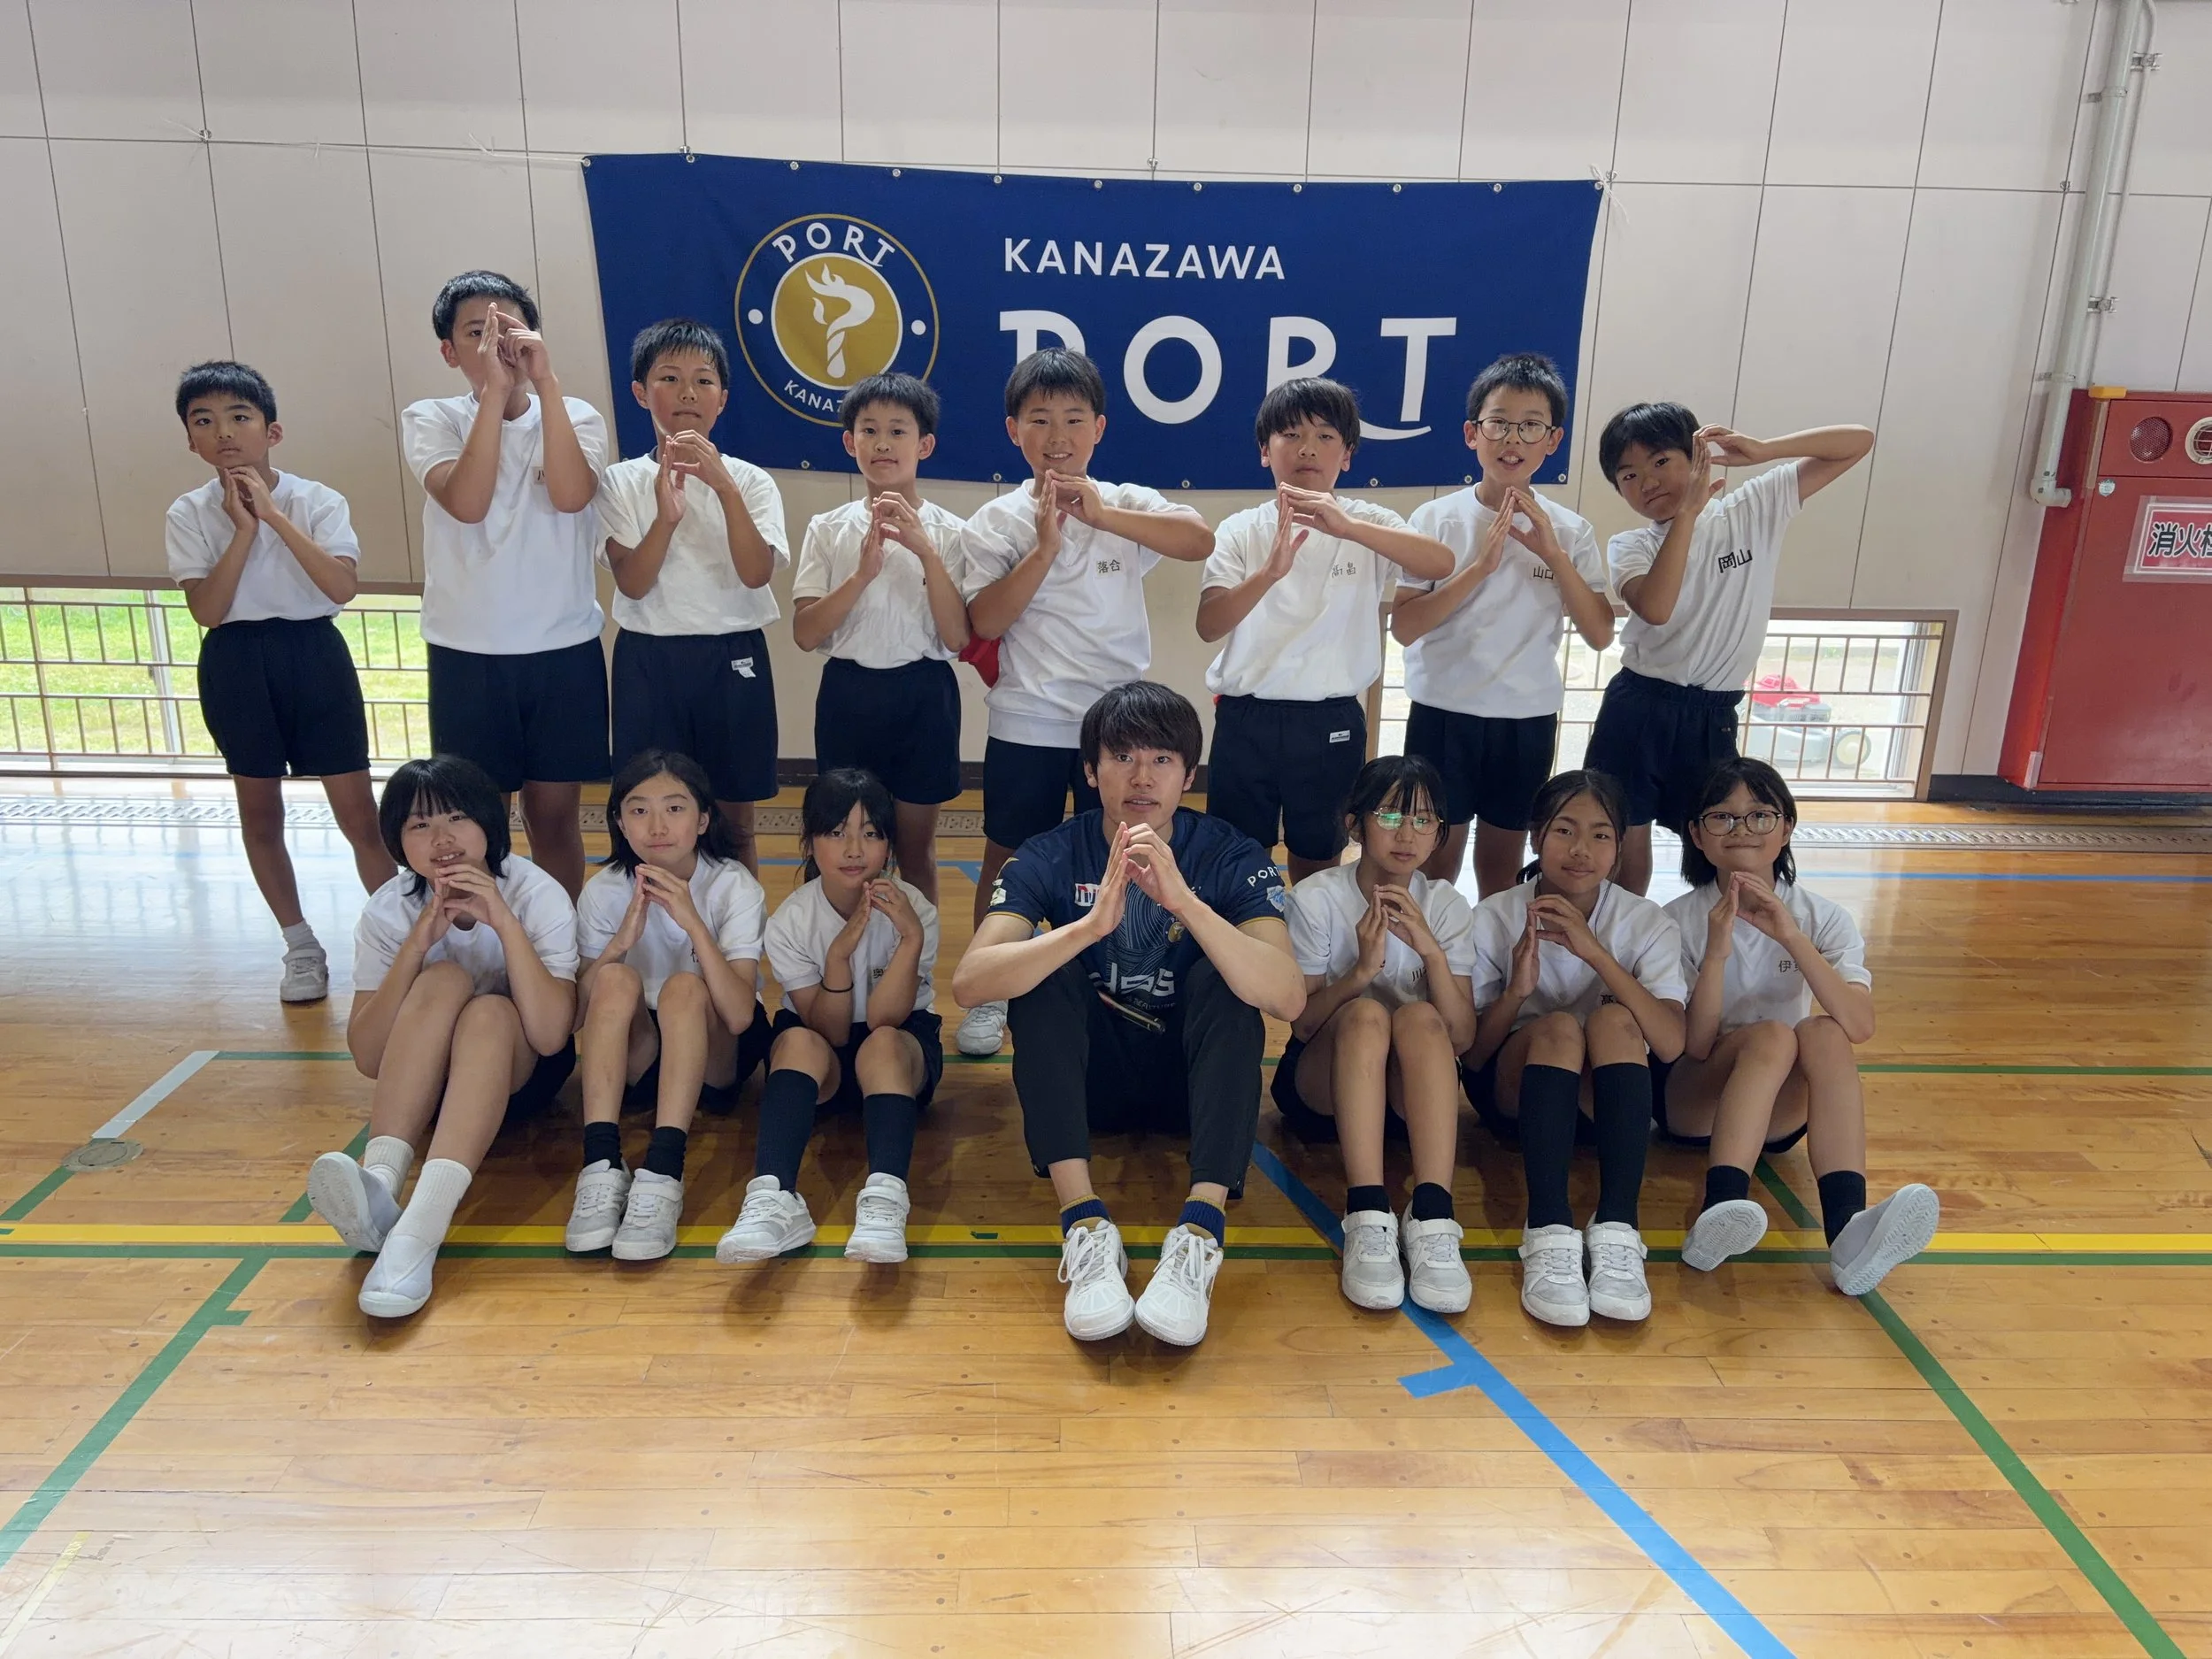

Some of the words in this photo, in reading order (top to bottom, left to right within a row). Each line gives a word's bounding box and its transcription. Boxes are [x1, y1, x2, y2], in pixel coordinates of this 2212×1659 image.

[772, 222, 895, 267] PORT
[1004, 237, 1286, 280] KANAZAWA
[1097, 559, 1120, 573] 落合
[1533, 565, 1555, 580] 山口
[1717, 549, 1753, 573] 岡山
